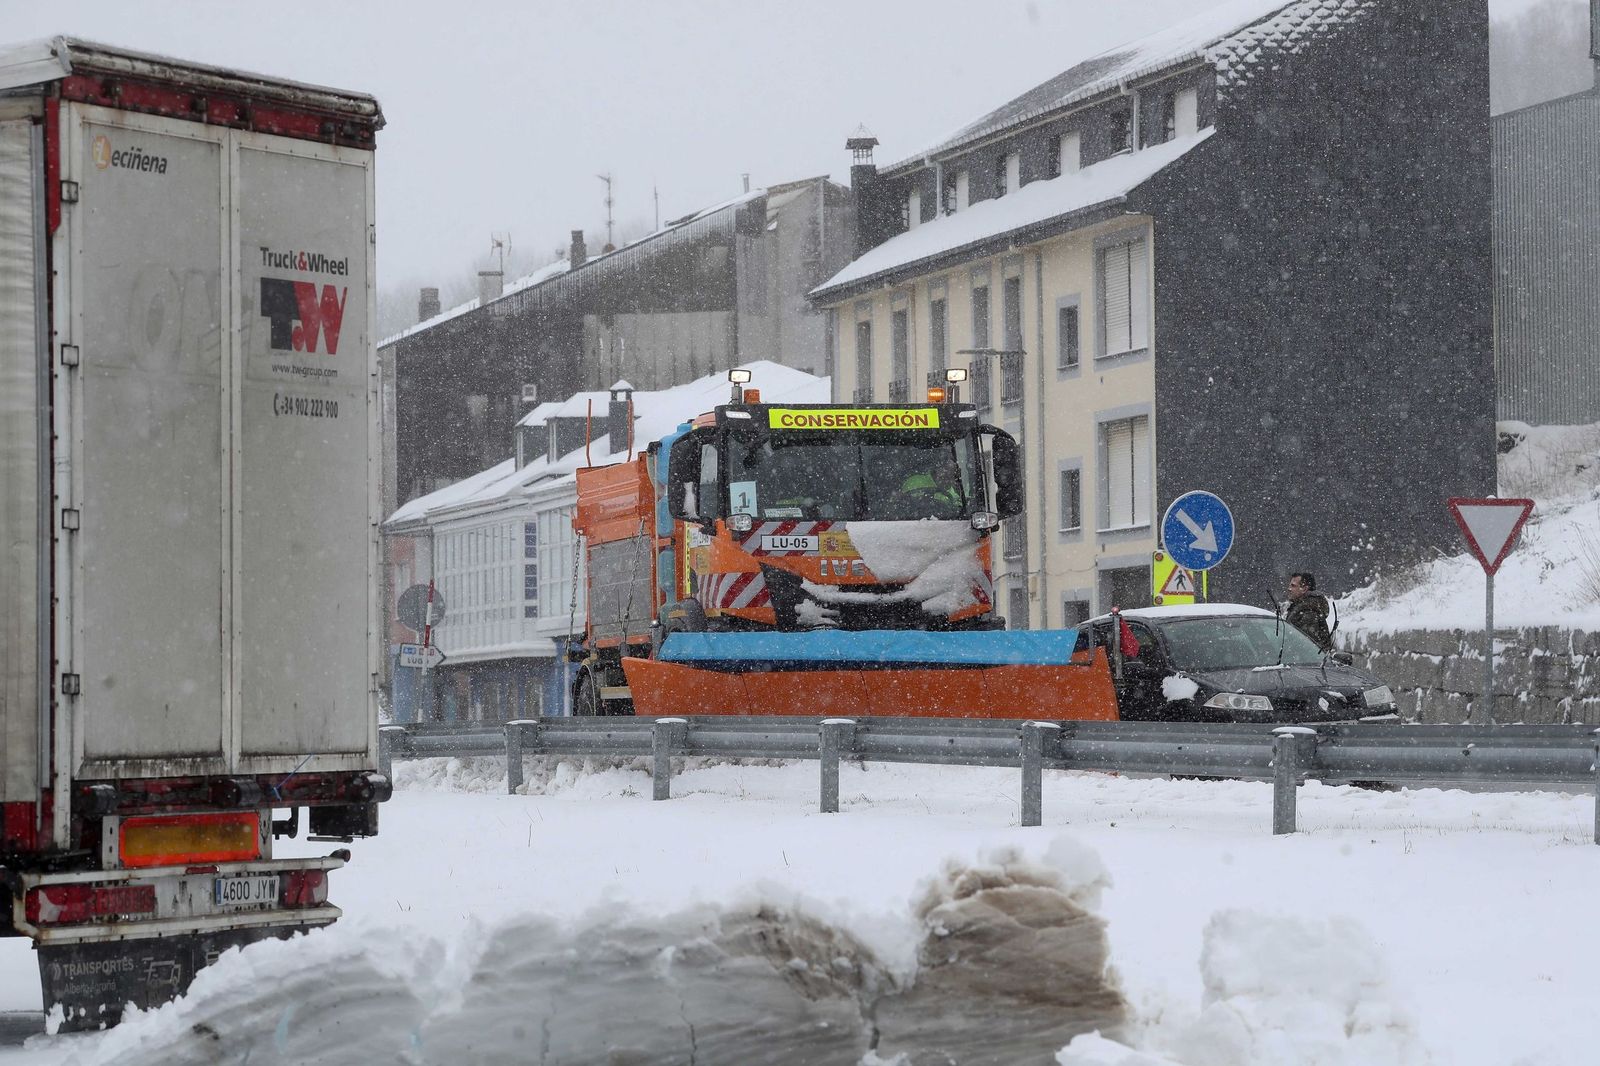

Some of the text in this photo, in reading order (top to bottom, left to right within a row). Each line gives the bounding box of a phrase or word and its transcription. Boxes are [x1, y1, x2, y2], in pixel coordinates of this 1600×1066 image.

[260, 247, 348, 276] Truck&Wheel
[295, 397, 308, 416] 902
[310, 399, 323, 417] 222
[325, 400, 338, 418] 900
[780, 411, 929, 427] CONSERVACIÓN
[738, 492, 750, 509] 1
[771, 537, 809, 549] LU-05
[820, 559, 865, 576] IVE
[223, 879, 276, 901] 4600 JYW
[63, 959, 134, 977] TRANSPORTES
